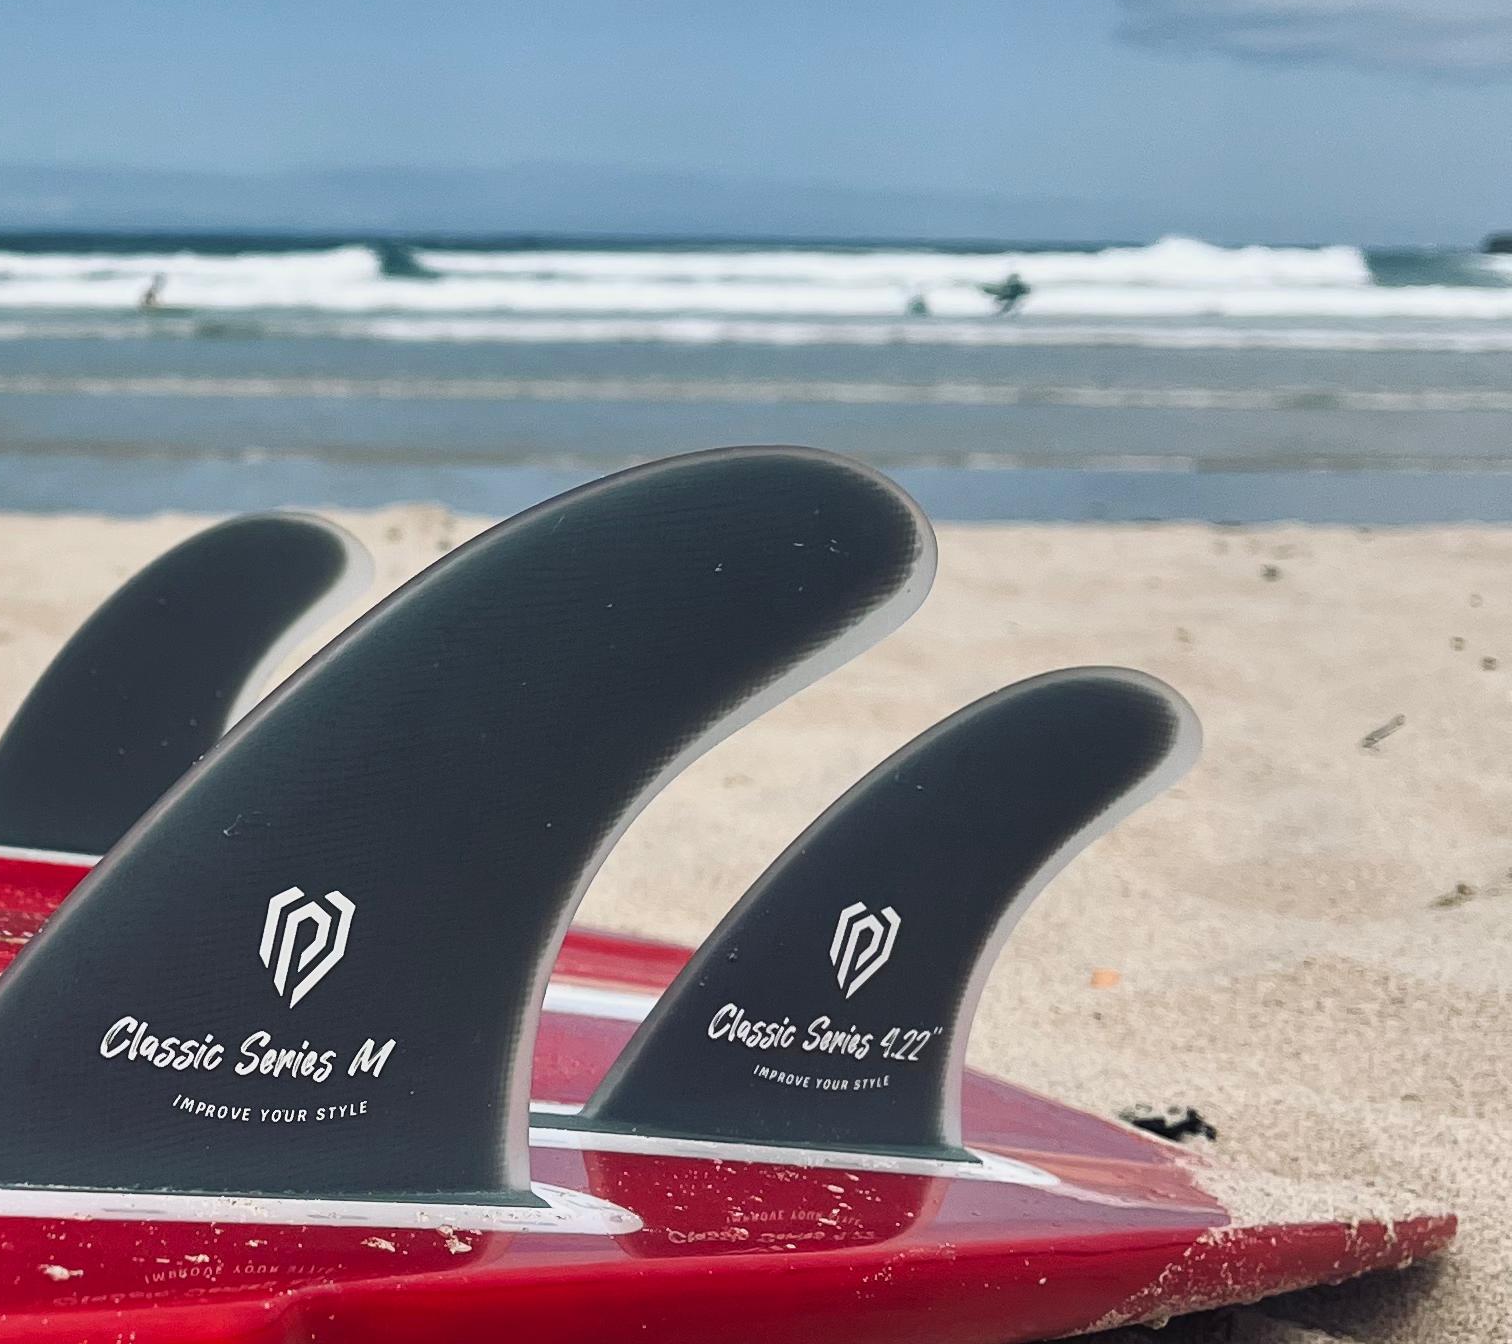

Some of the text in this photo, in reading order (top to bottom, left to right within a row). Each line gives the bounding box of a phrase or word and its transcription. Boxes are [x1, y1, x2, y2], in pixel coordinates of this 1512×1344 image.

[99, 1016, 397, 1083] Classic Series M
[707, 1003, 797, 1049] Classic
[802, 1015, 874, 1060] Series
[753, 1064, 890, 1091] IMPROVE YOUR STYLE
[172, 1094, 368, 1123] IMPROVE YOUR STYLE
